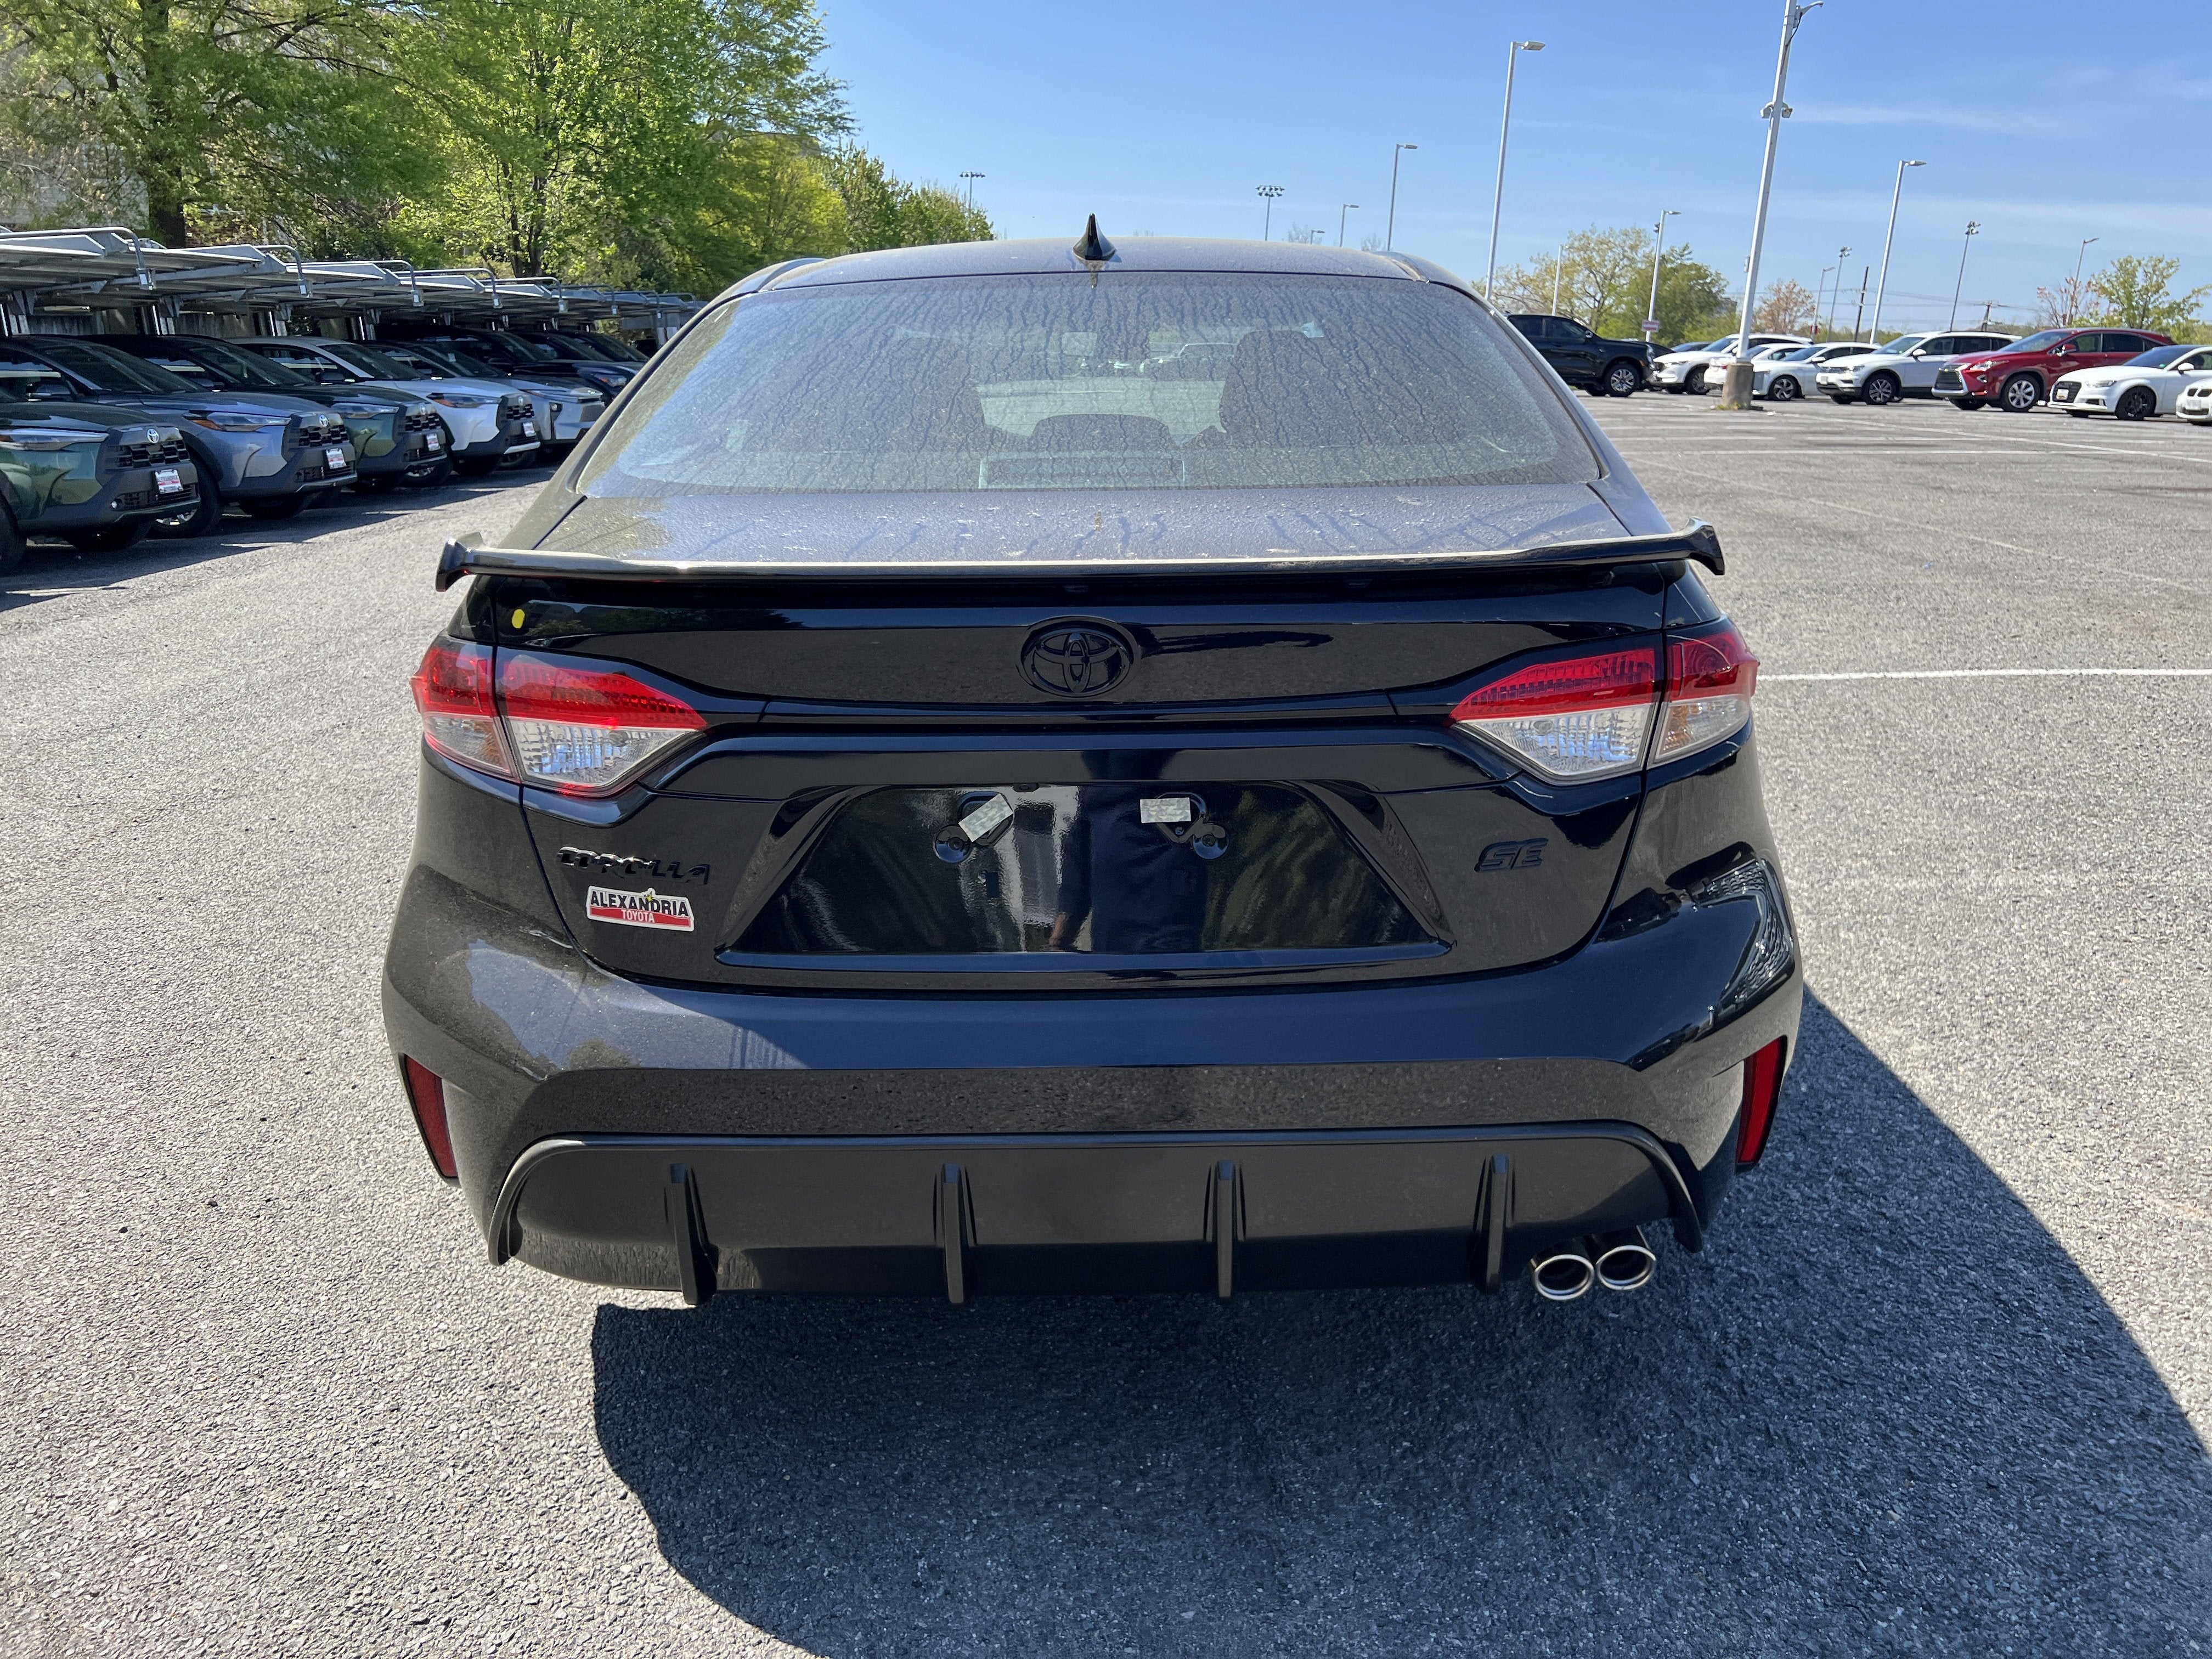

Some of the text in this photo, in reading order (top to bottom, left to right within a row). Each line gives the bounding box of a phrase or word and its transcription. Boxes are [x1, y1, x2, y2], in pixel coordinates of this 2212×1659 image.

[557, 846, 711, 885] COROLLA
[1474, 837, 1549, 872] SE
[591, 890, 689, 916] ALEXANDRIA
[621, 909, 655, 923] TOYOTA
